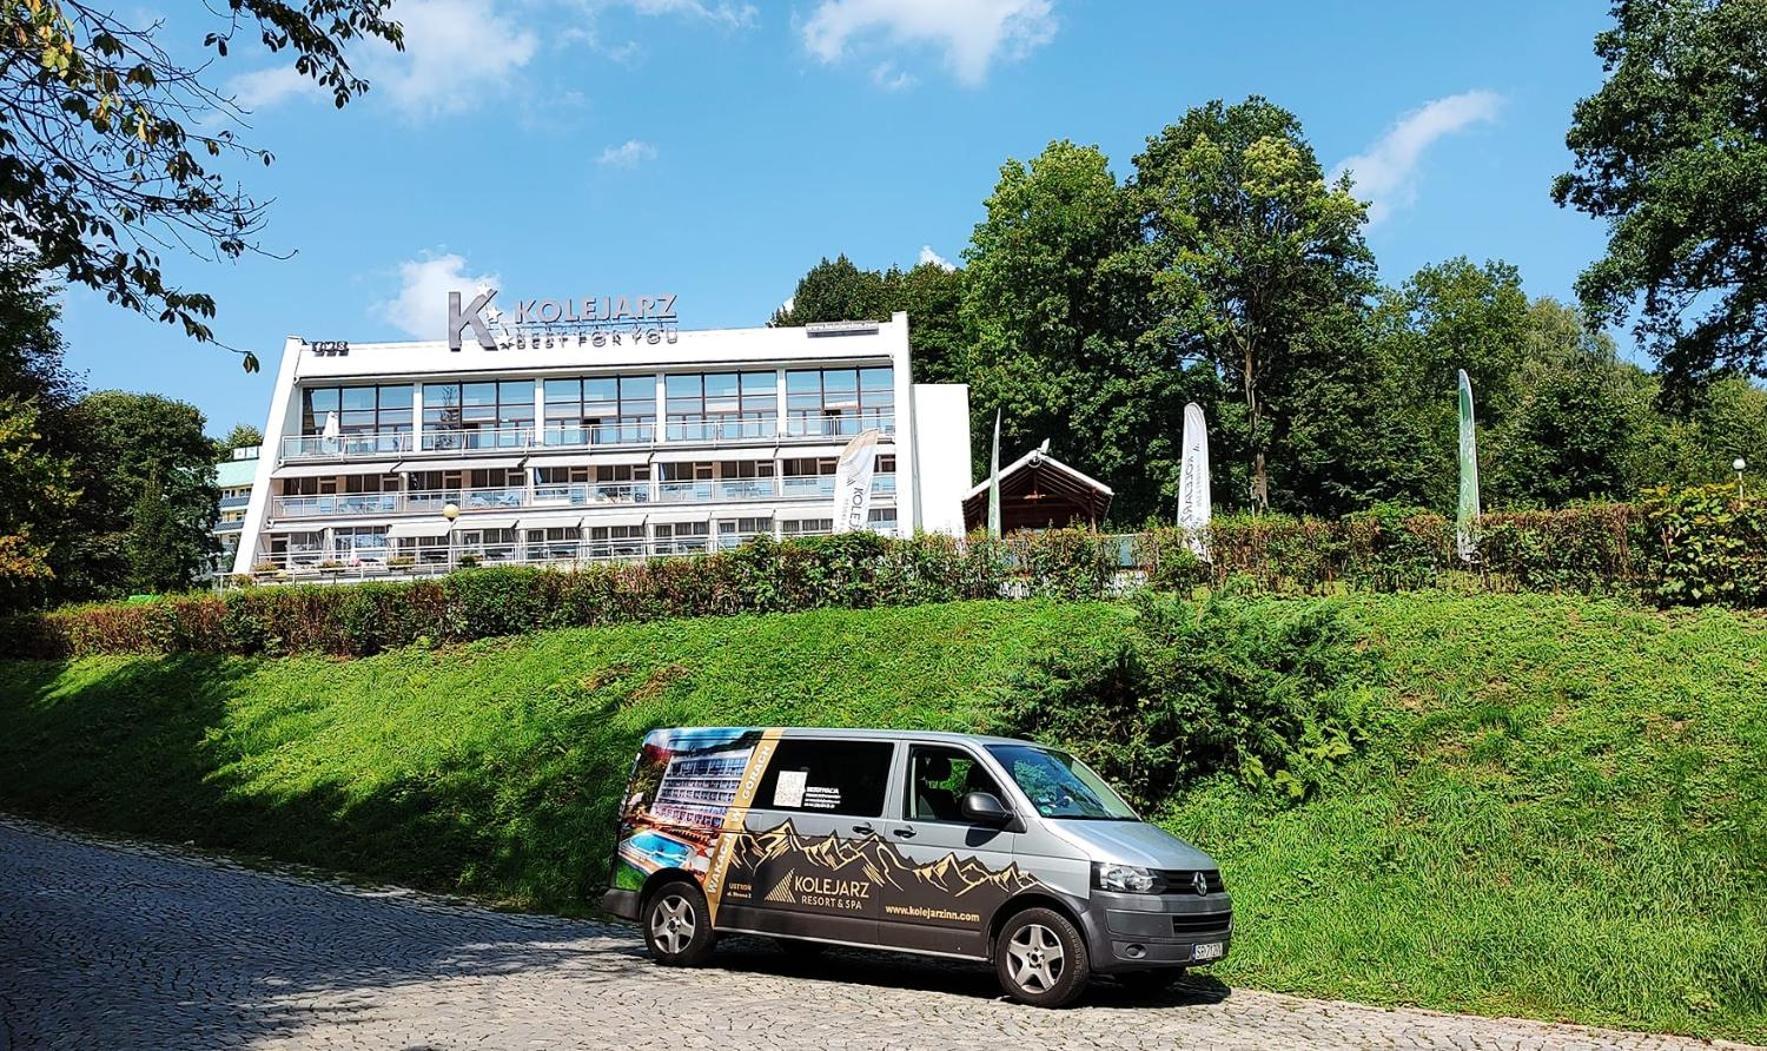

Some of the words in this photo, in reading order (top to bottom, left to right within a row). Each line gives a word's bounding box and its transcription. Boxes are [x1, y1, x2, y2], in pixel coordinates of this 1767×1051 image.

[514, 294, 678, 324] KOLEJARZ
[449, 289, 498, 352] K
[517, 331, 569, 350] BEST
[578, 330, 622, 348] FOR
[632, 327, 678, 345] YOU
[795, 876, 869, 898] KOLEJARZ
[801, 895, 835, 908] RESORT
[837, 899, 843, 908] &
[845, 900, 862, 910] SPA
[885, 905, 980, 922] www.kolejarzinn.com
